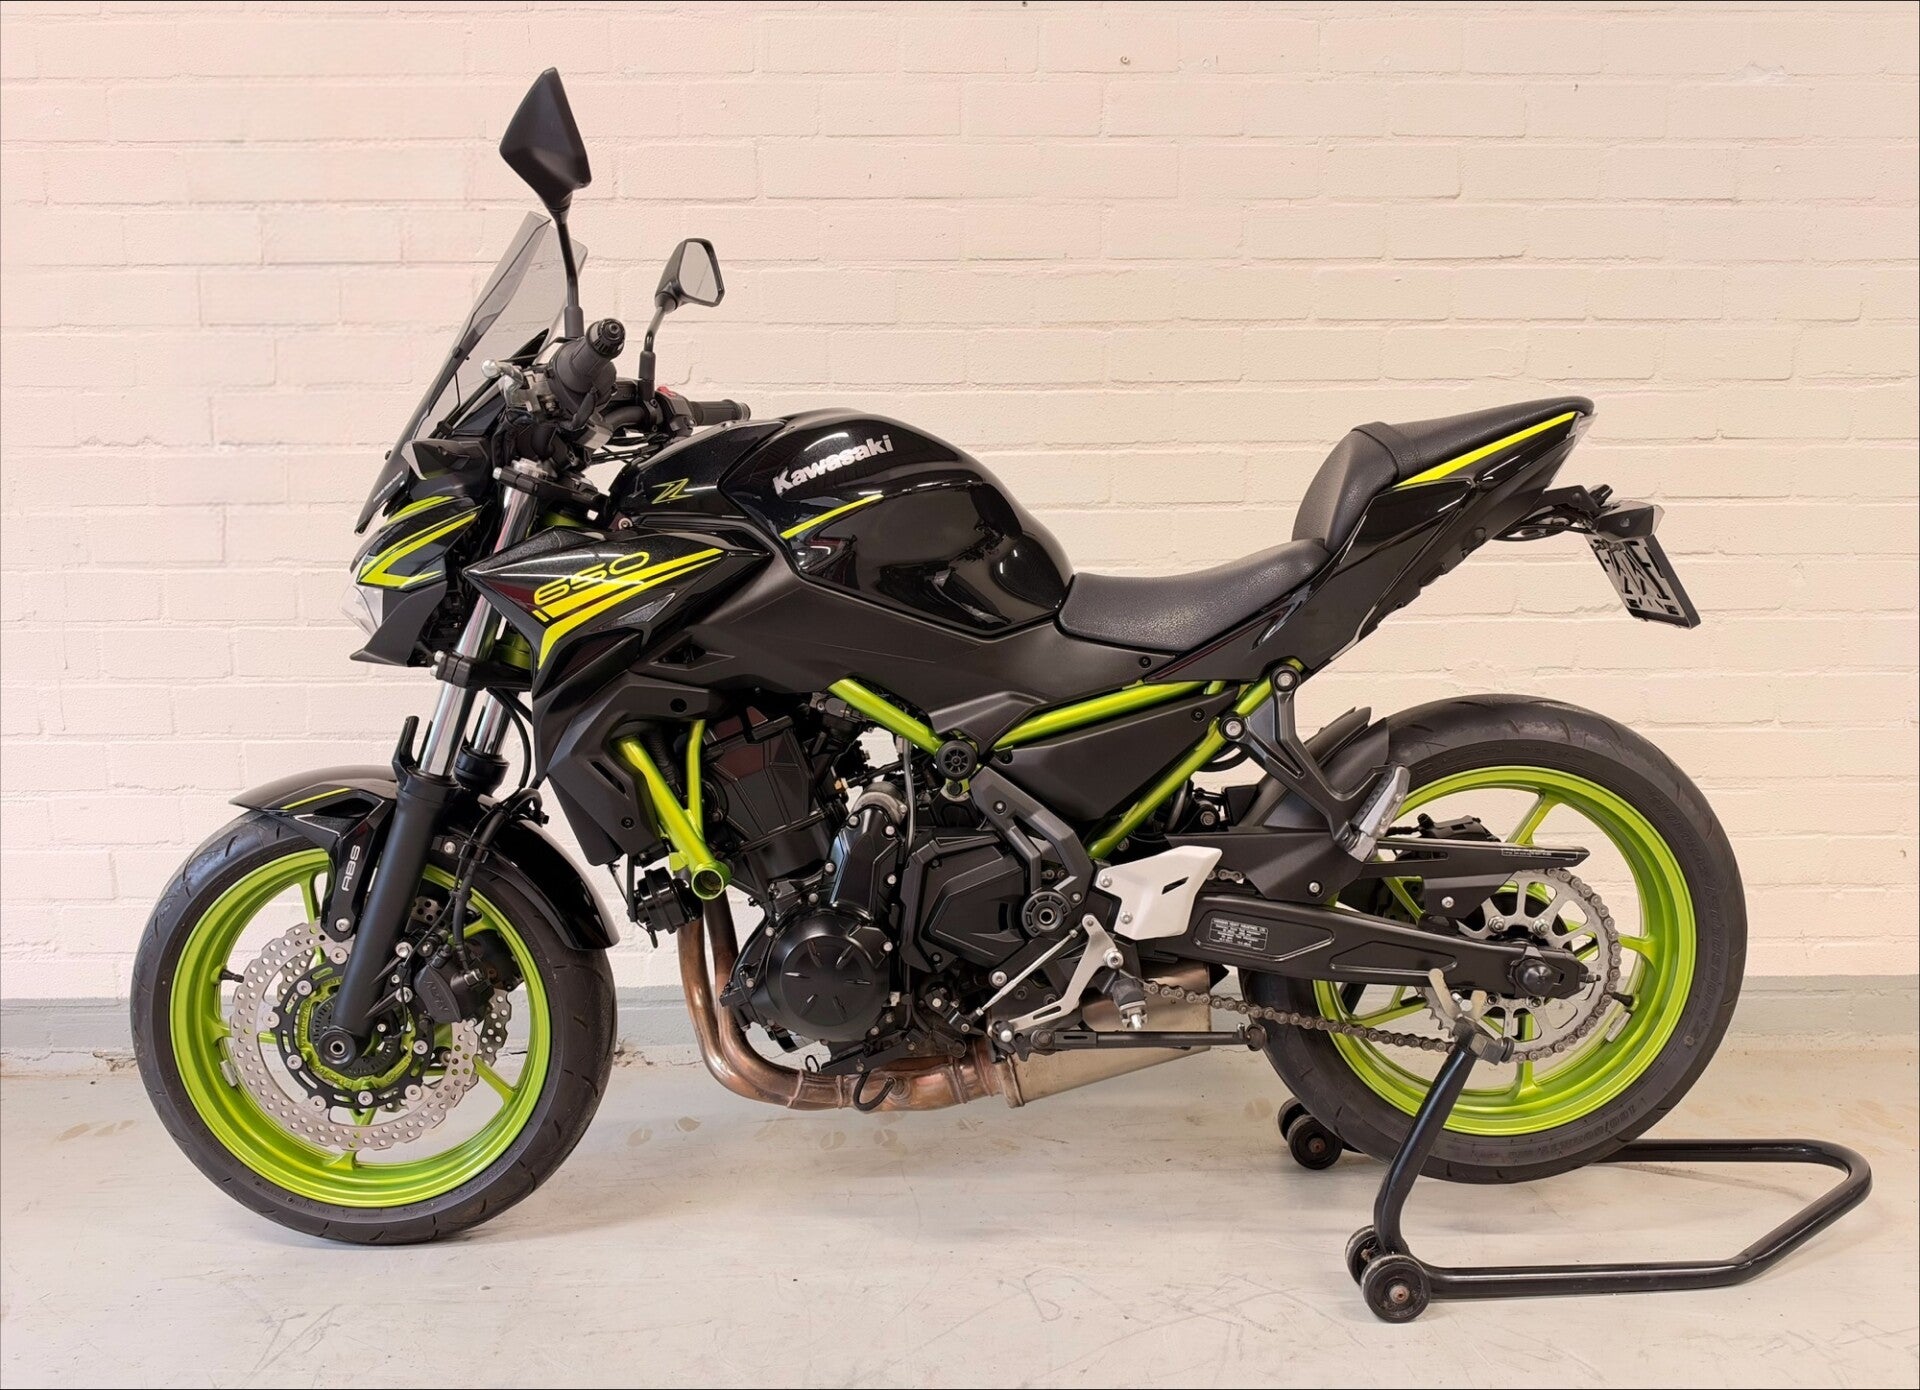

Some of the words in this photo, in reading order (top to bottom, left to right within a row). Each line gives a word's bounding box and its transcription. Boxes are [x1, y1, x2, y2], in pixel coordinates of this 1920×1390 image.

[772, 434, 894, 496] Kawasaki
[533, 551, 650, 606] 650
[341, 845, 360, 891] ABS
